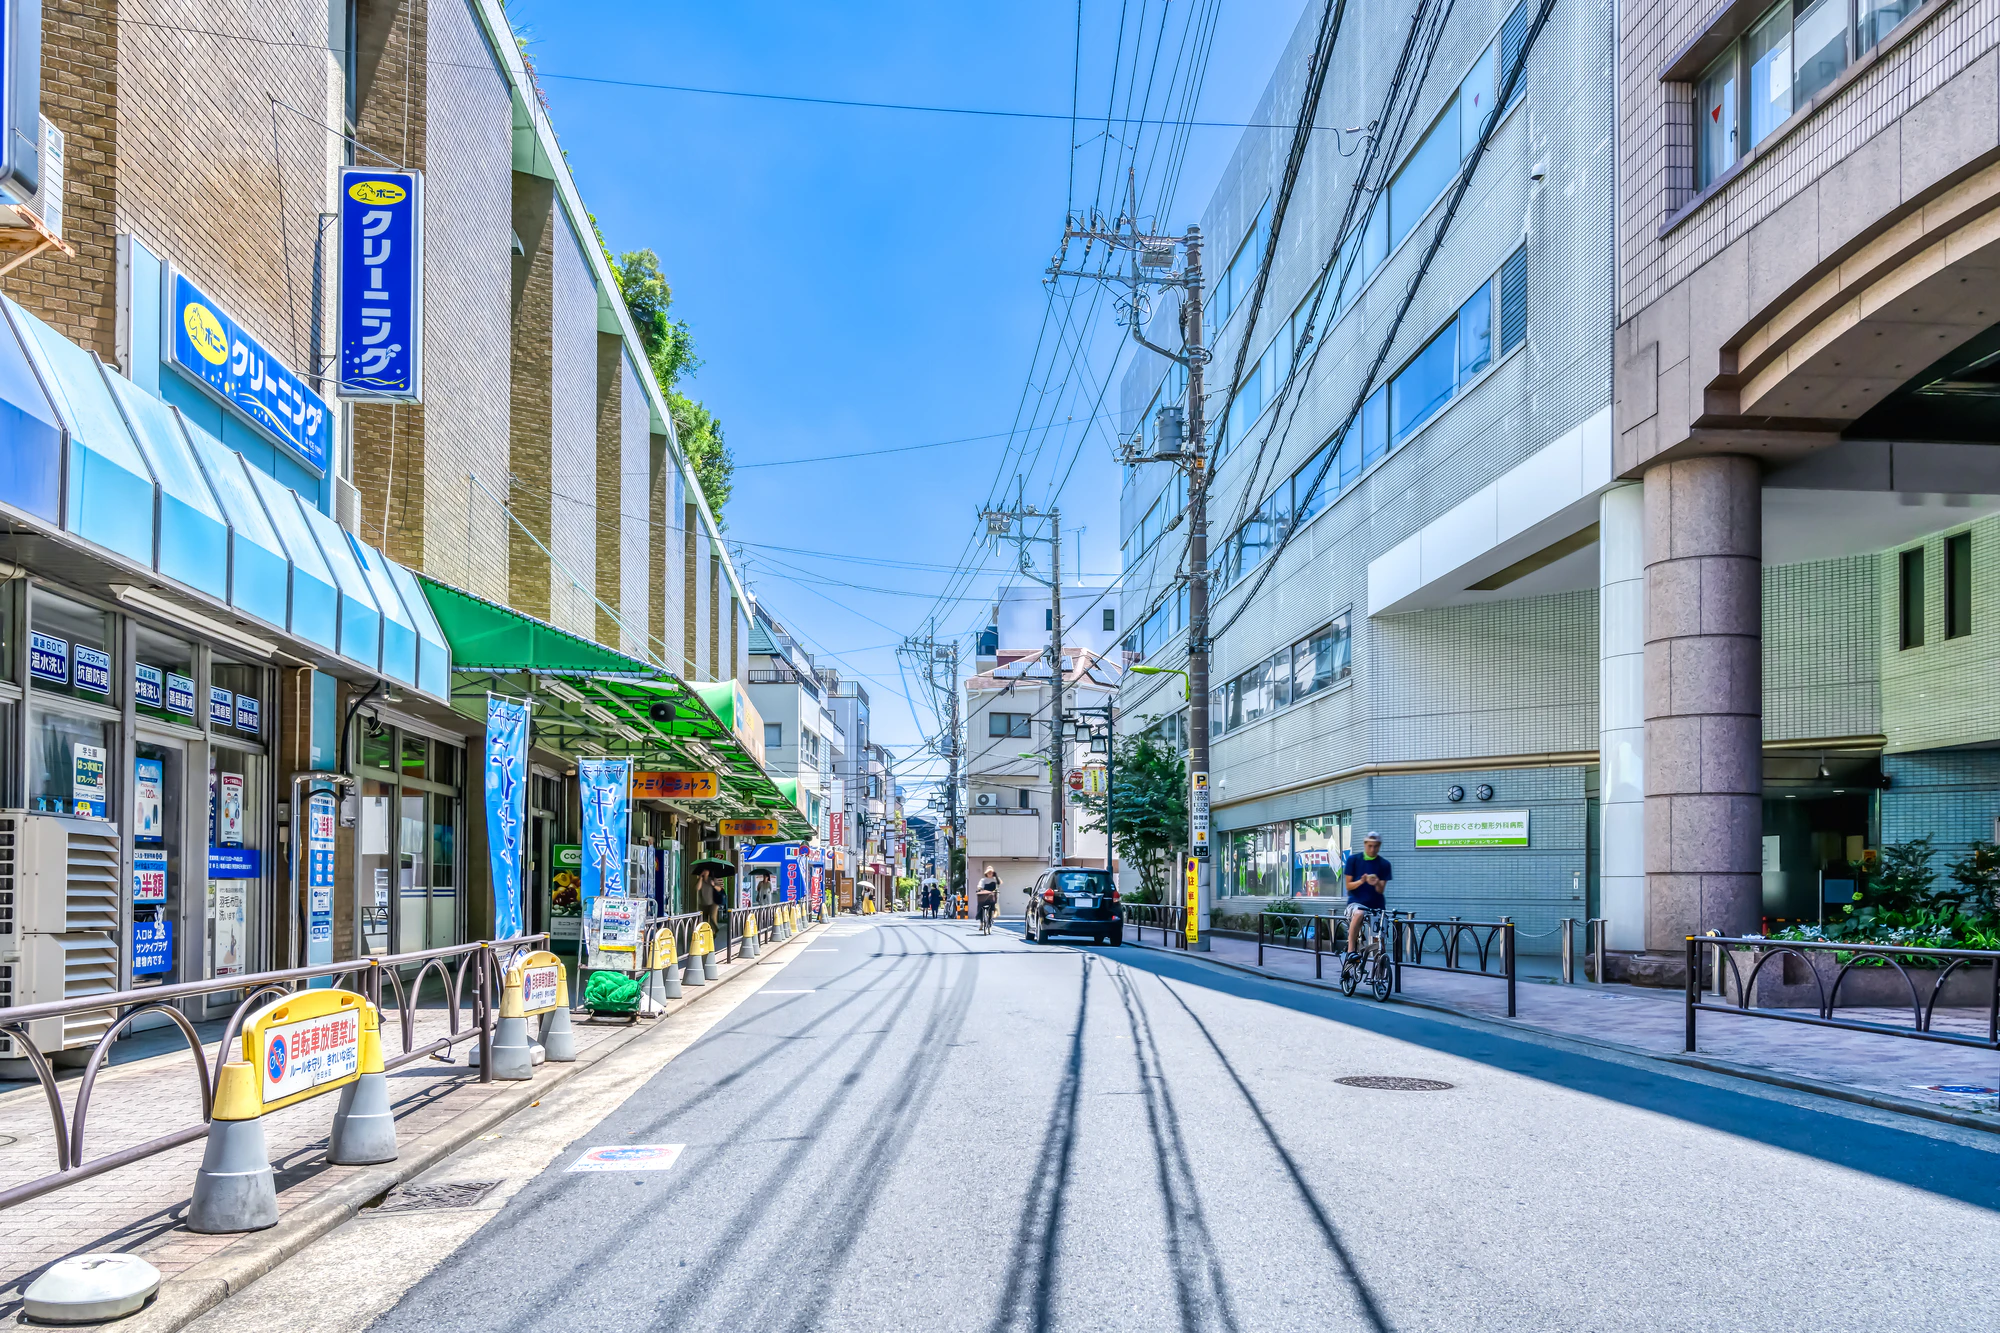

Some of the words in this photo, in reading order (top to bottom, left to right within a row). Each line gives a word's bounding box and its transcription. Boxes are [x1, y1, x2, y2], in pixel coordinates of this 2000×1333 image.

[376, 189, 402, 199] ポニー
[362, 210, 400, 375] クリーニング
[204, 328, 226, 353] ポニー
[232, 339, 322, 436] クリーニング
[32, 651, 65, 674] 温水洗い
[77, 664, 107, 686] 抗菌防臭
[1196, 776, 1206, 784] P
[1433, 821, 1524, 831] 世田谷おくさわ整形外科病院
[141, 872, 164, 898] 半額
[787, 863, 797, 903] クリーニン
[136, 930, 153, 940] 入口は
[136, 941, 168, 953] サンケイプラザ
[291, 1018, 356, 1060] 自転車放置禁止
[290, 1057, 323, 1078] ルールを守り
